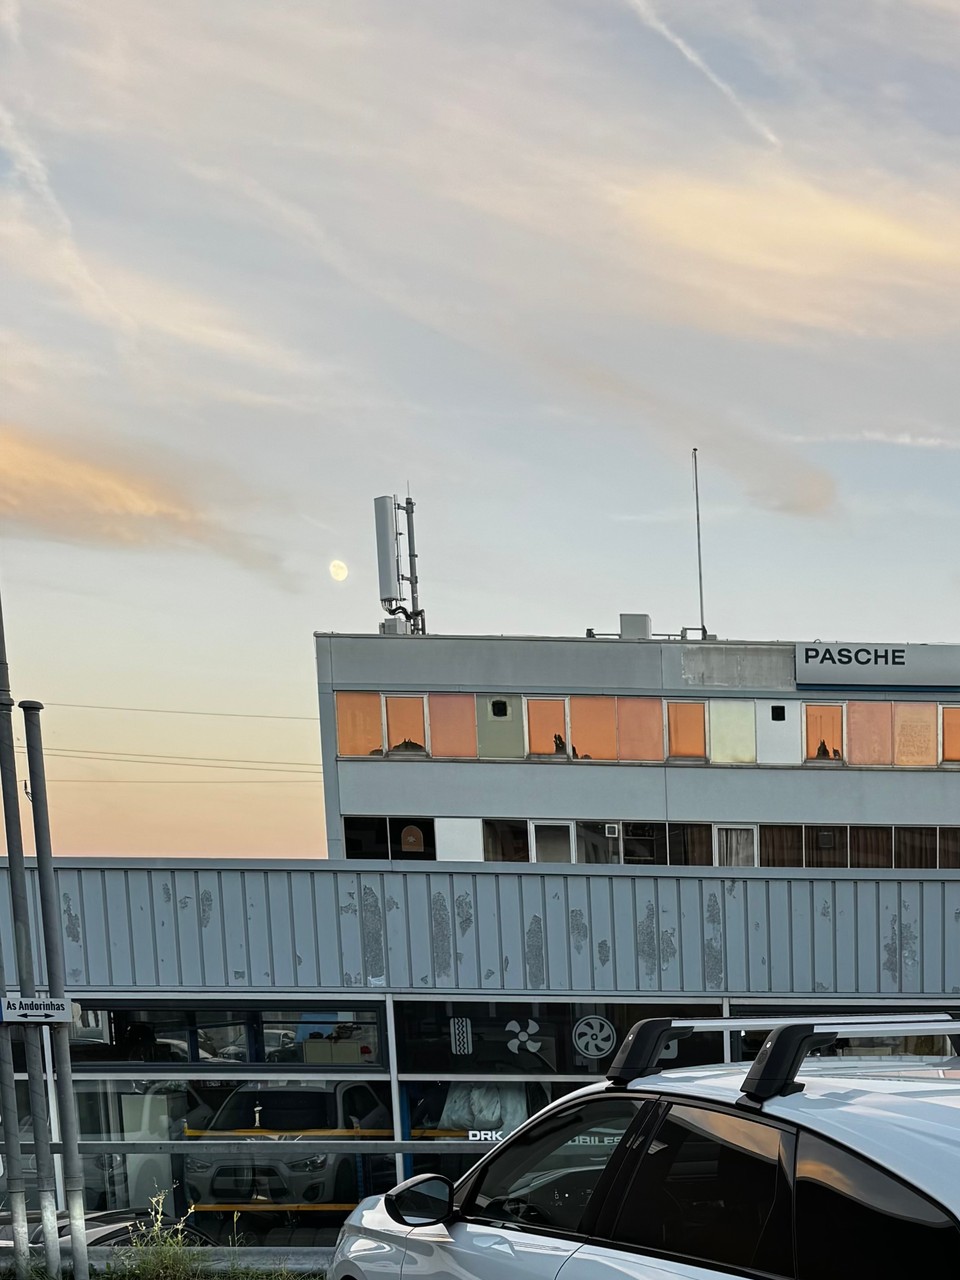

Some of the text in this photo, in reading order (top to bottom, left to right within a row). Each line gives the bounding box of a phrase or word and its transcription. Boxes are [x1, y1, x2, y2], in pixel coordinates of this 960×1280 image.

[804, 647, 906, 666] PASCHE
[6, 1000, 66, 1011] As Andorinhas
[468, 1130, 503, 1141] DRK
